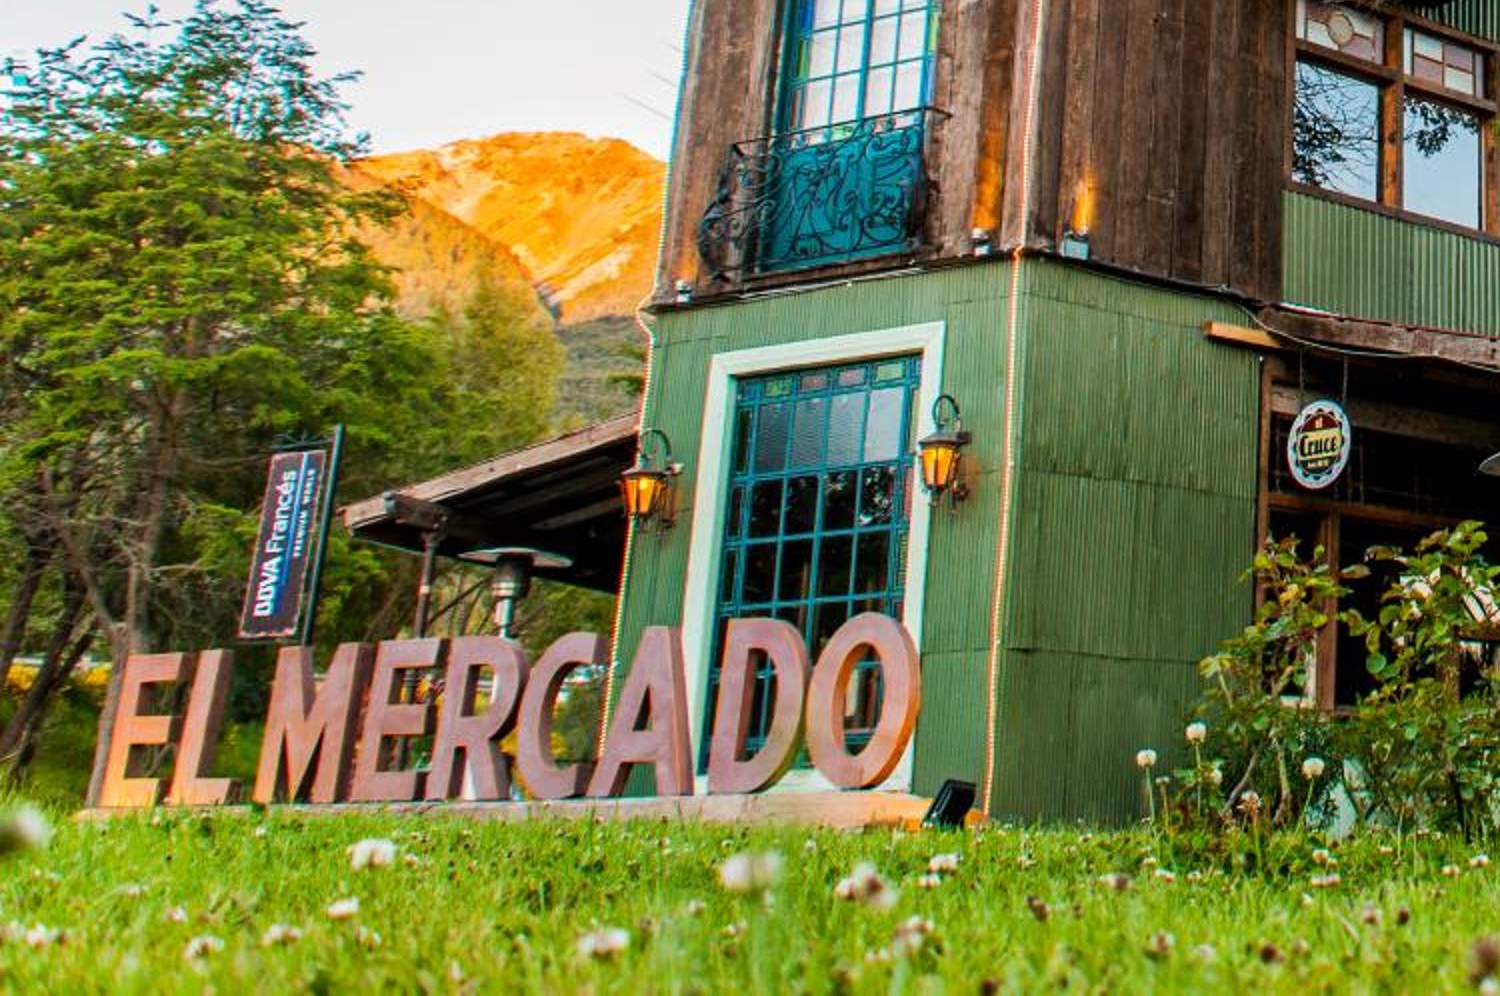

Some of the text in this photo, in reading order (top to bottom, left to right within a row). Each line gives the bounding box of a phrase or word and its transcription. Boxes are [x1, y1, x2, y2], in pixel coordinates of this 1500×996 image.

[1300, 435, 1337, 458] Cruce
[252, 469, 298, 617] BBVA Francés
[100, 612, 922, 808] EL MERCADO
